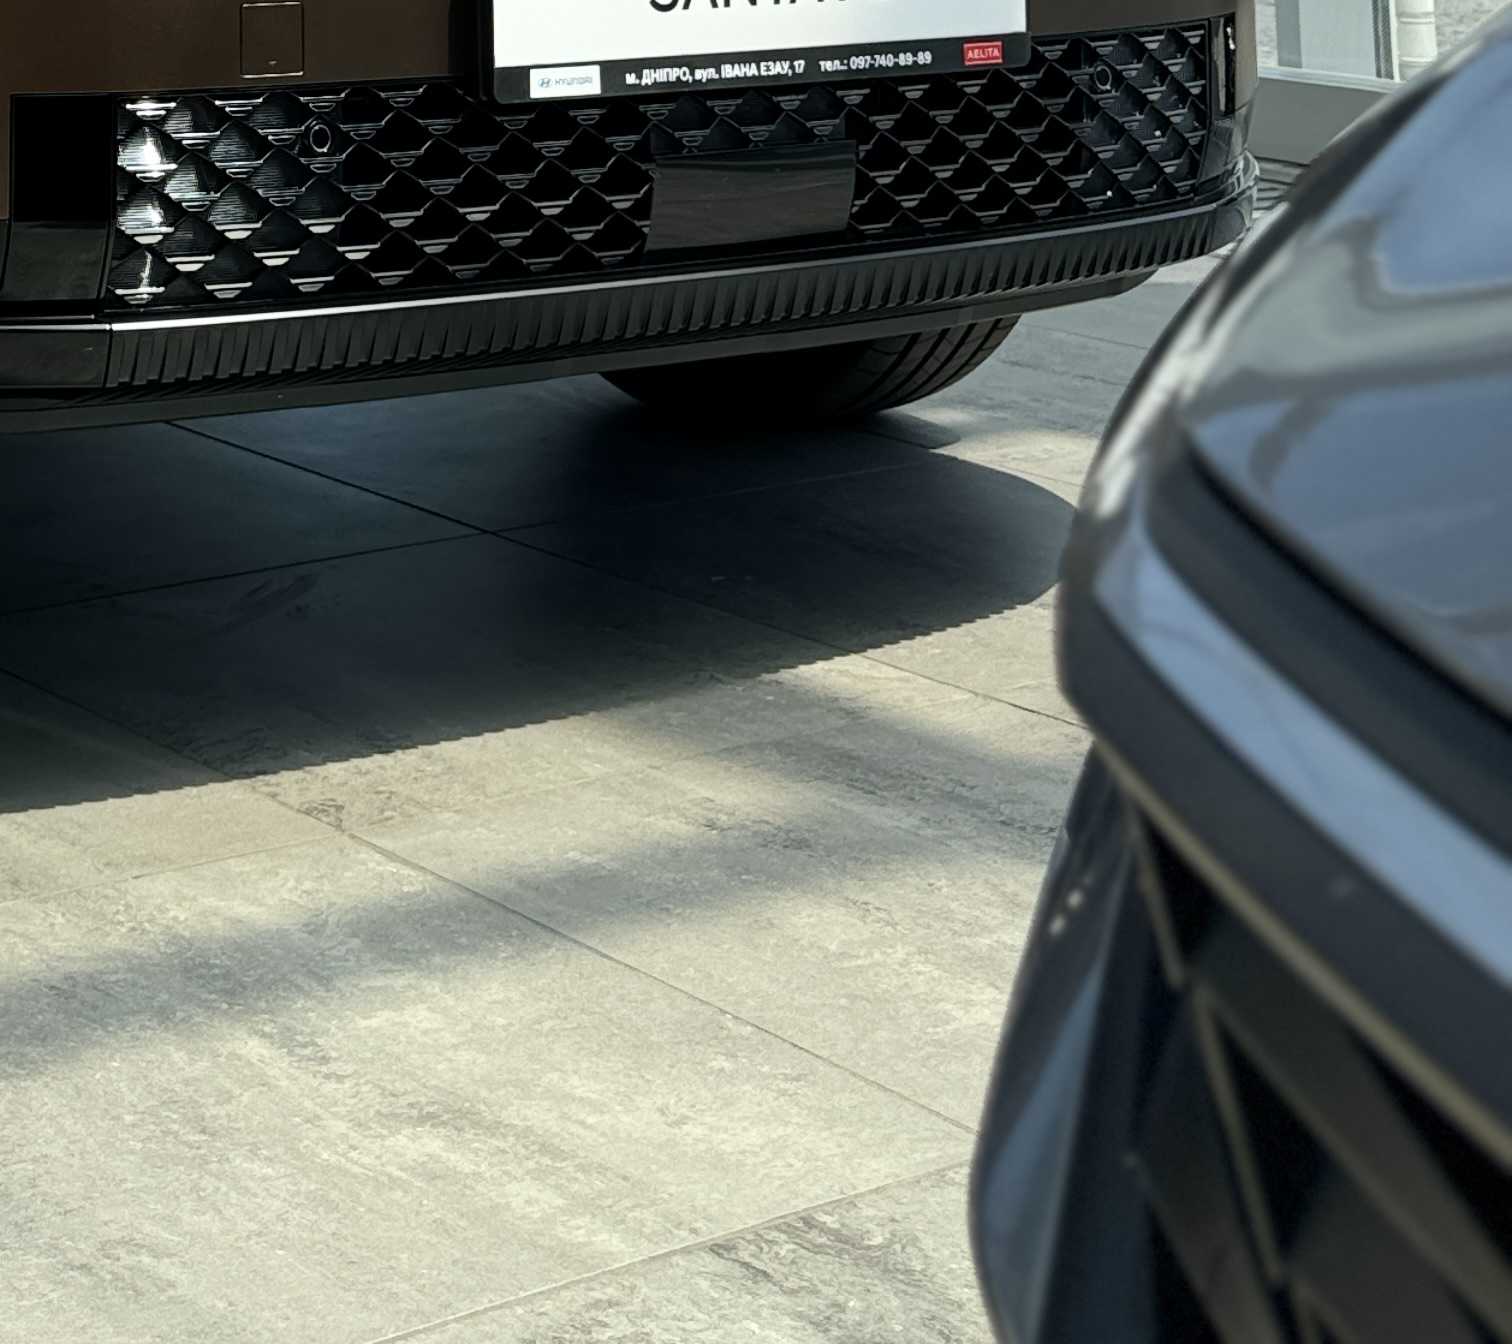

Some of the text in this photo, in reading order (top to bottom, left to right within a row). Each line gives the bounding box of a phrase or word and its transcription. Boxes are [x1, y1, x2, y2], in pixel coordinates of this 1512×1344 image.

[625, 72, 641, 85] м.
[641, 66, 693, 86] ДНІПРО,
[694, 67, 720, 83] вул.
[720, 62, 759, 79] ІВАНА
[759, 60, 792, 77] ЕЗАУ,
[792, 59, 806, 74] 17
[849, 50, 932, 70] 097-740-89-89
